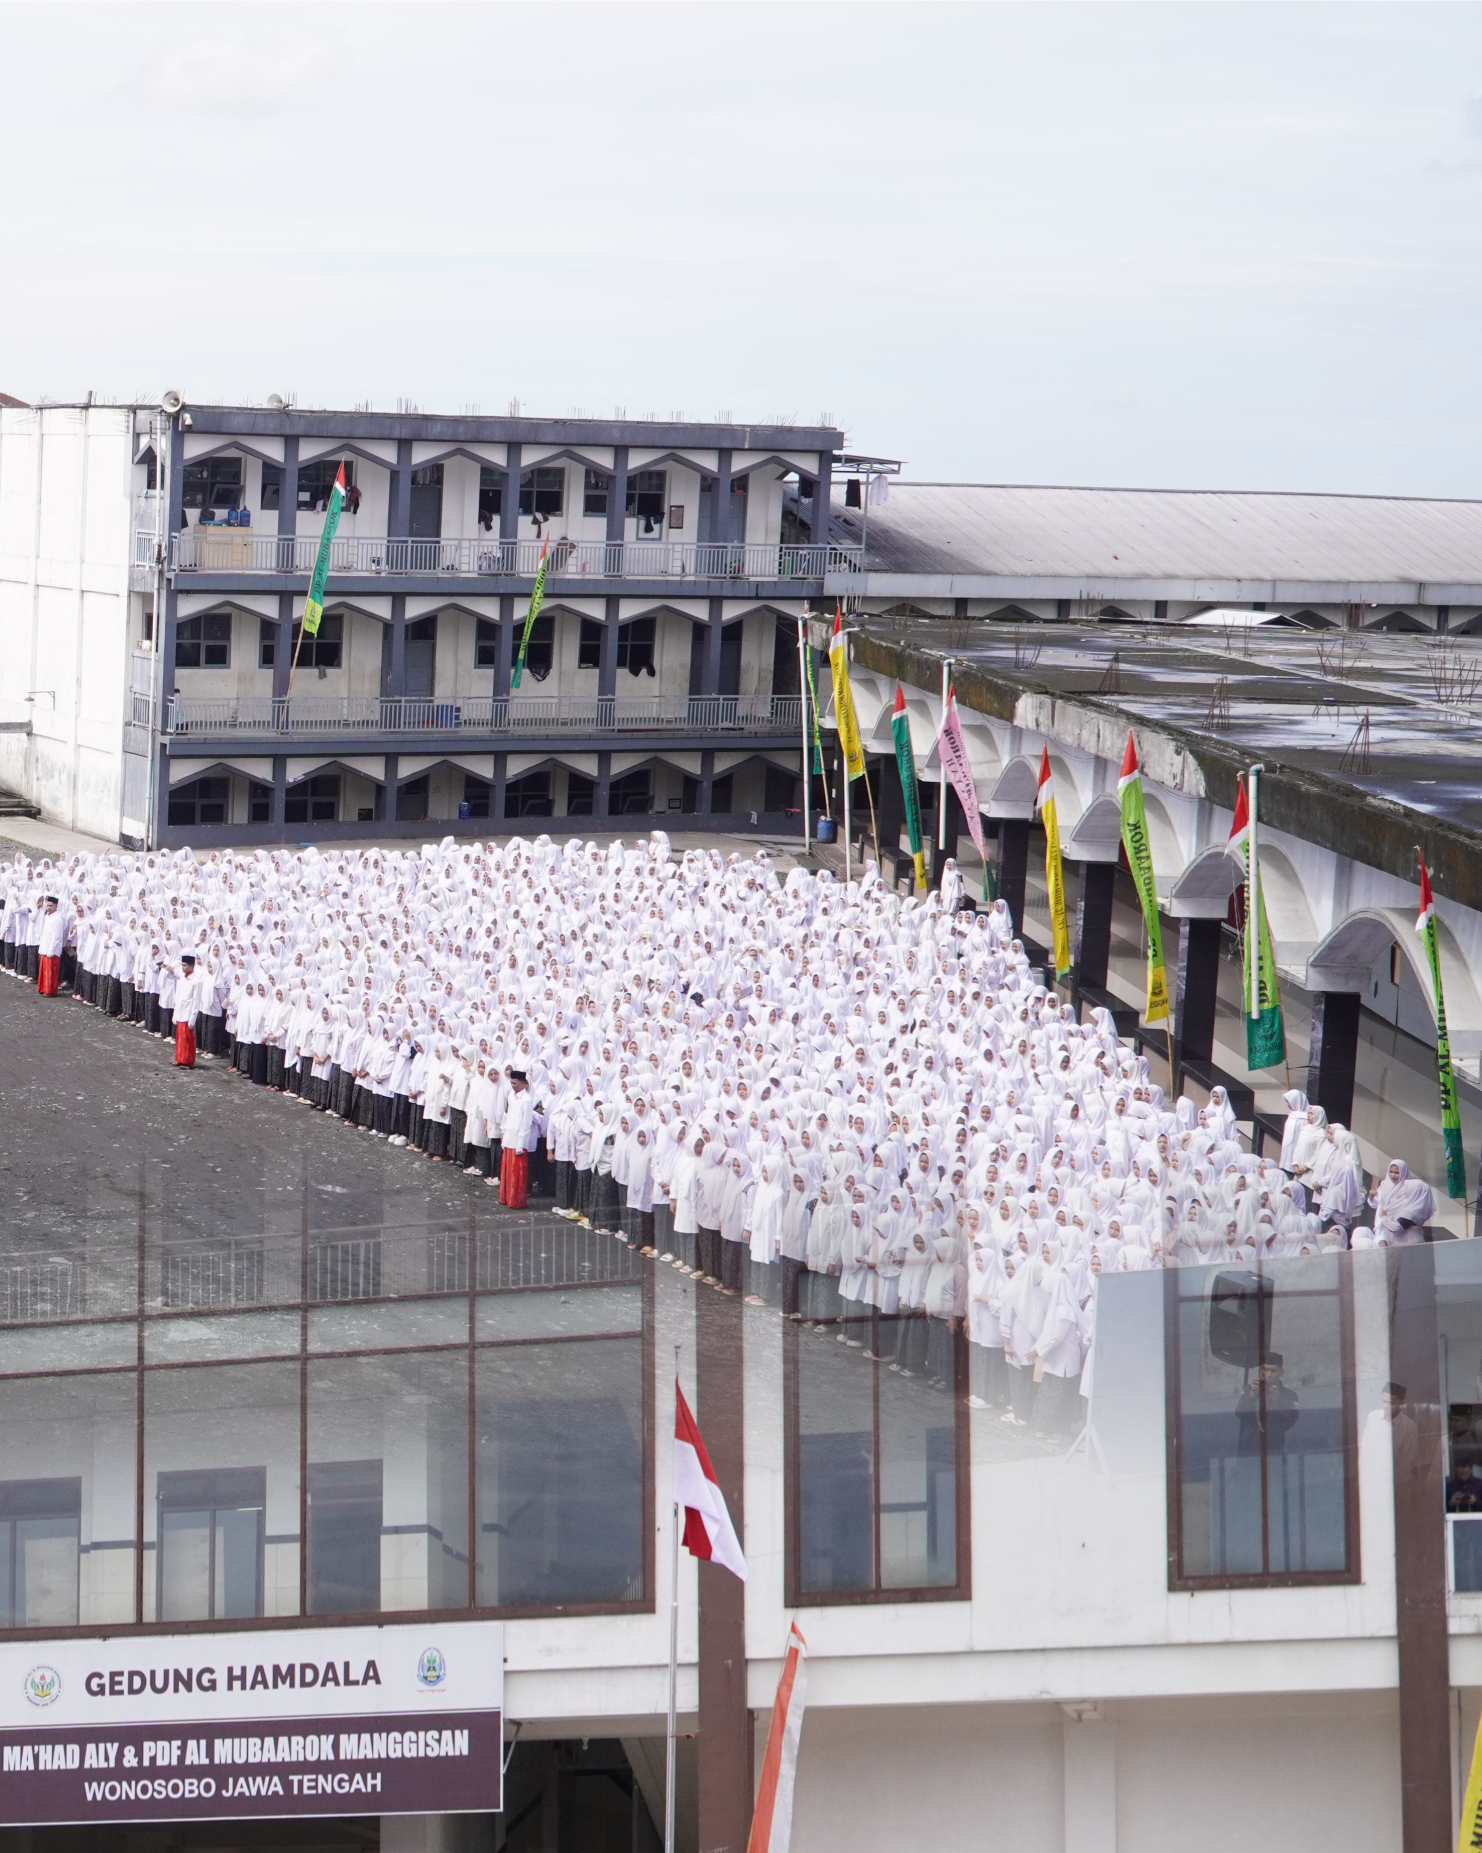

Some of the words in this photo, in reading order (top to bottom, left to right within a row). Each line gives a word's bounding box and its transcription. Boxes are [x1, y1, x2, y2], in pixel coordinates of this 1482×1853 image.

[84, 1666, 218, 1698] GEDUNG
[226, 1659, 382, 1692] HAMDALA
[3, 1743, 80, 1772] MA’HAD
[84, 1742, 119, 1769] ALY
[122, 1745, 139, 1768] &
[143, 1740, 182, 1767] PDF
[185, 1739, 210, 1766] AL
[214, 1734, 335, 1765] MUBAAROK
[339, 1729, 469, 1760] MANGGISAN
[84, 1778, 216, 1801] WONOSOBO
[221, 1775, 284, 1797] JAWA
[289, 1772, 382, 1795] TENGAH
